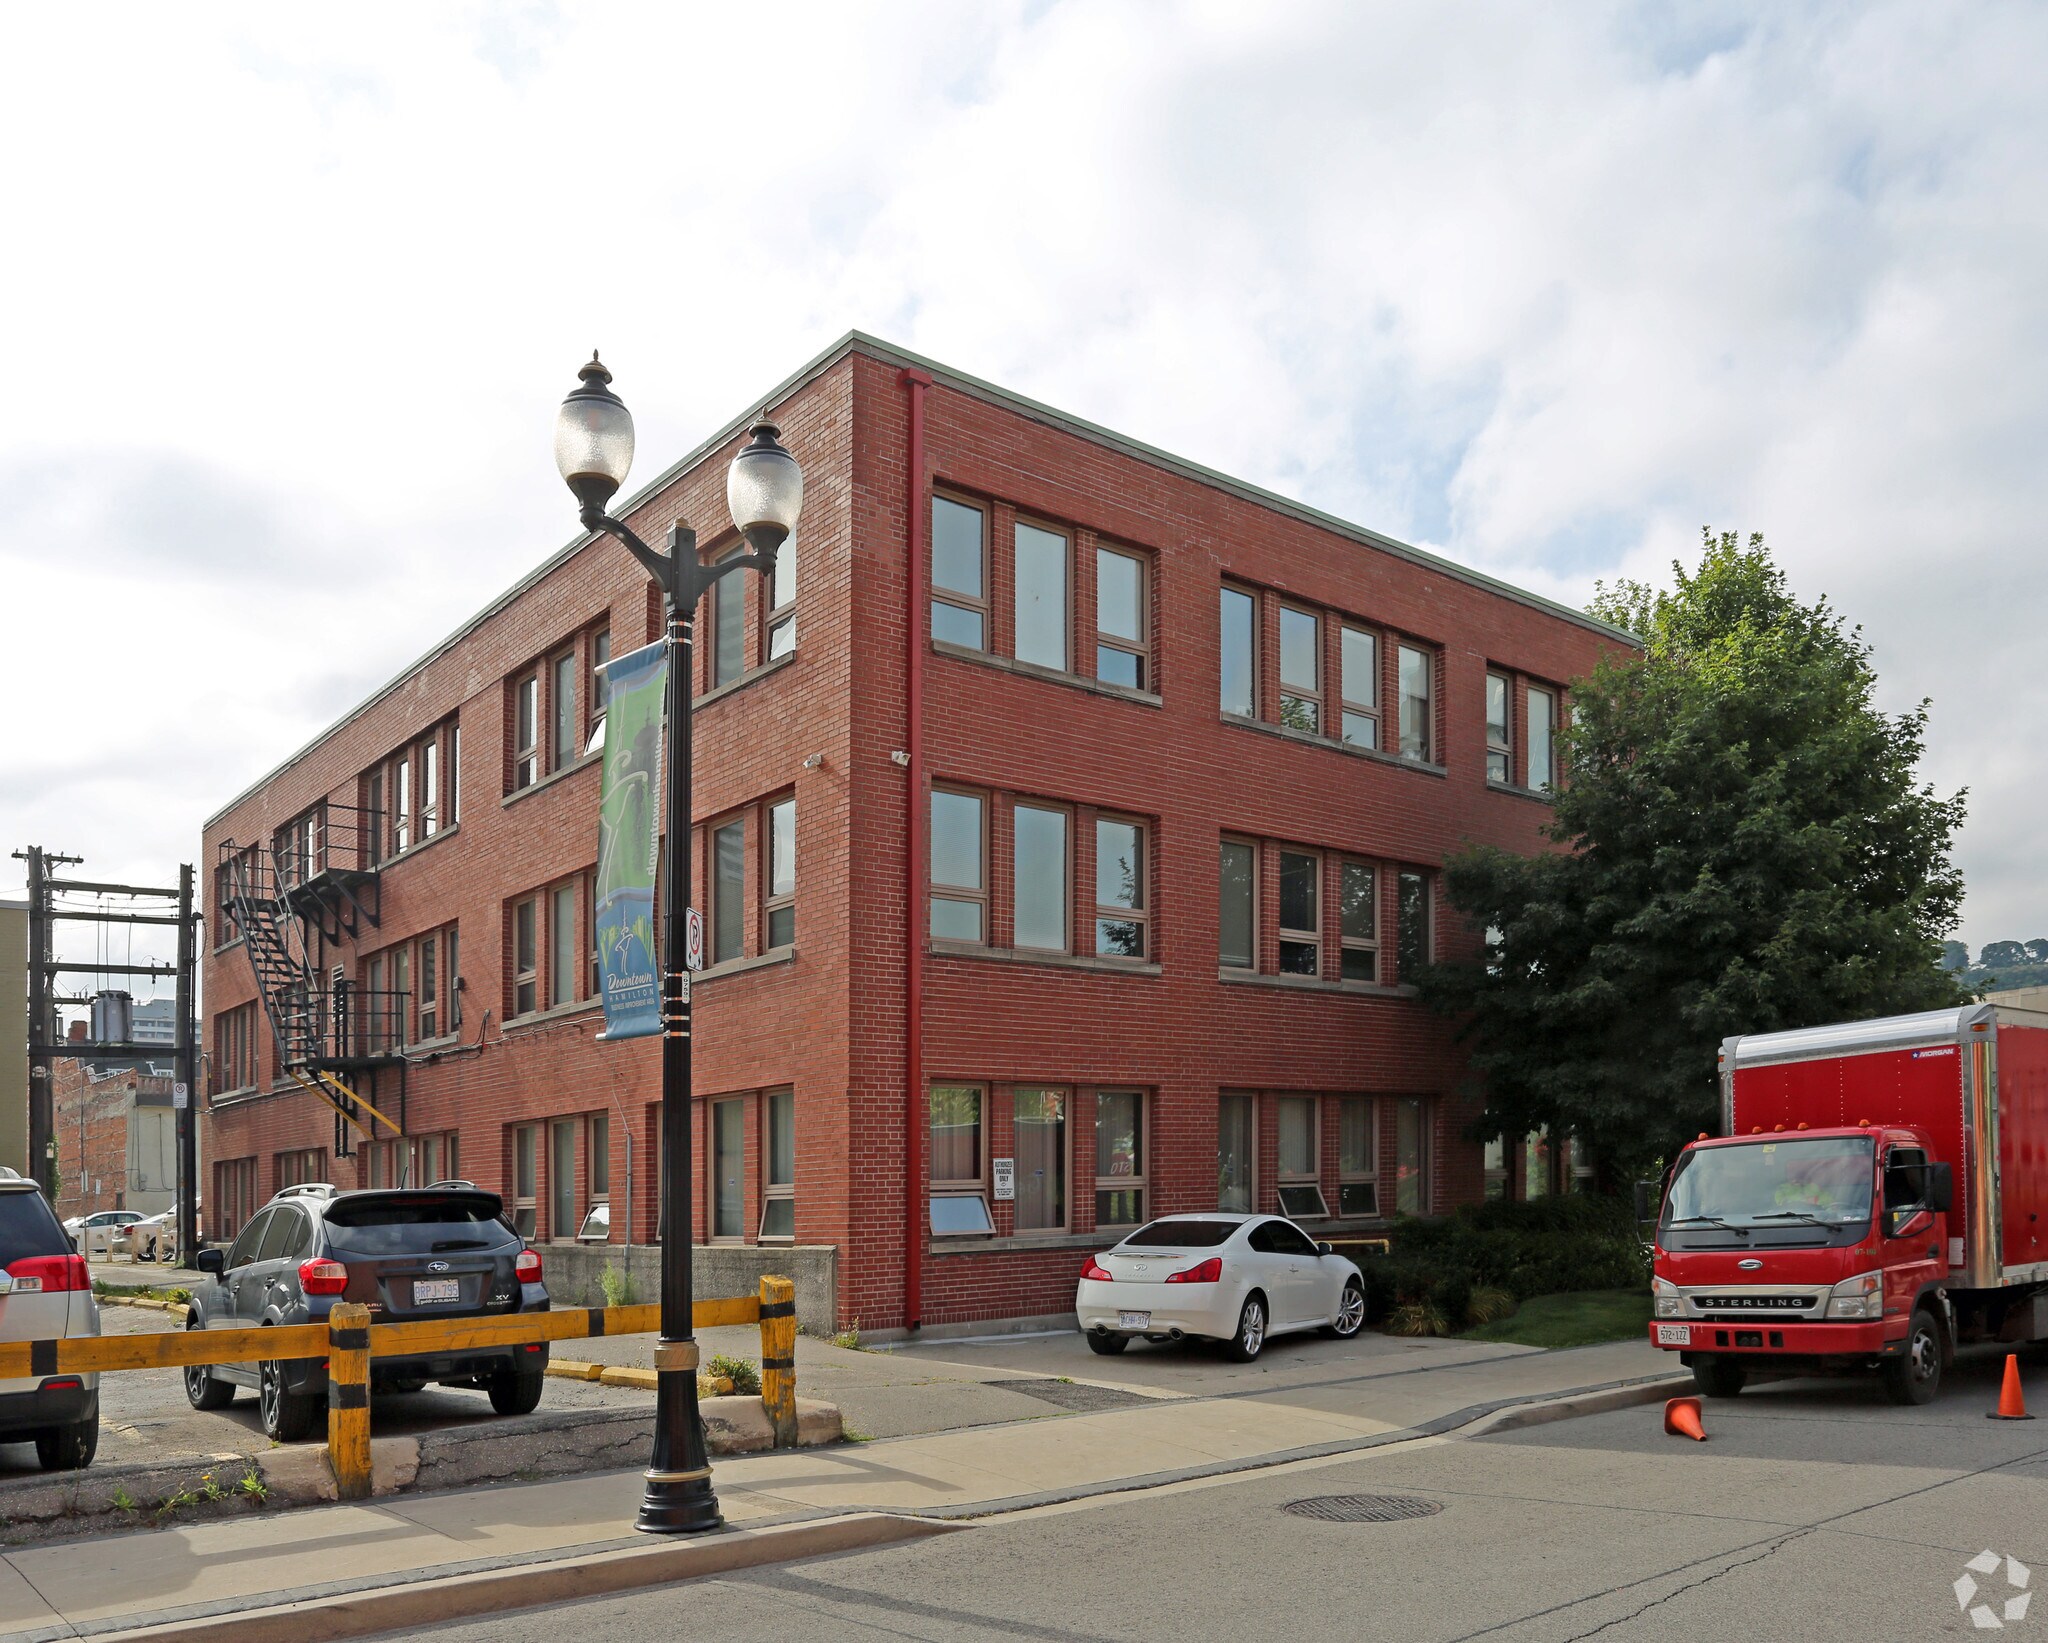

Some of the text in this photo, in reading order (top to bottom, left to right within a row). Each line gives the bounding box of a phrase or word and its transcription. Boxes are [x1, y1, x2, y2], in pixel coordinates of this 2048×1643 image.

[607, 973, 653, 990] Downtown
[609, 988, 654, 1002] HAMILTON
[1919, 1049, 1953, 1057] MORGAN
[1705, 1299, 1803, 1307] STERLING
